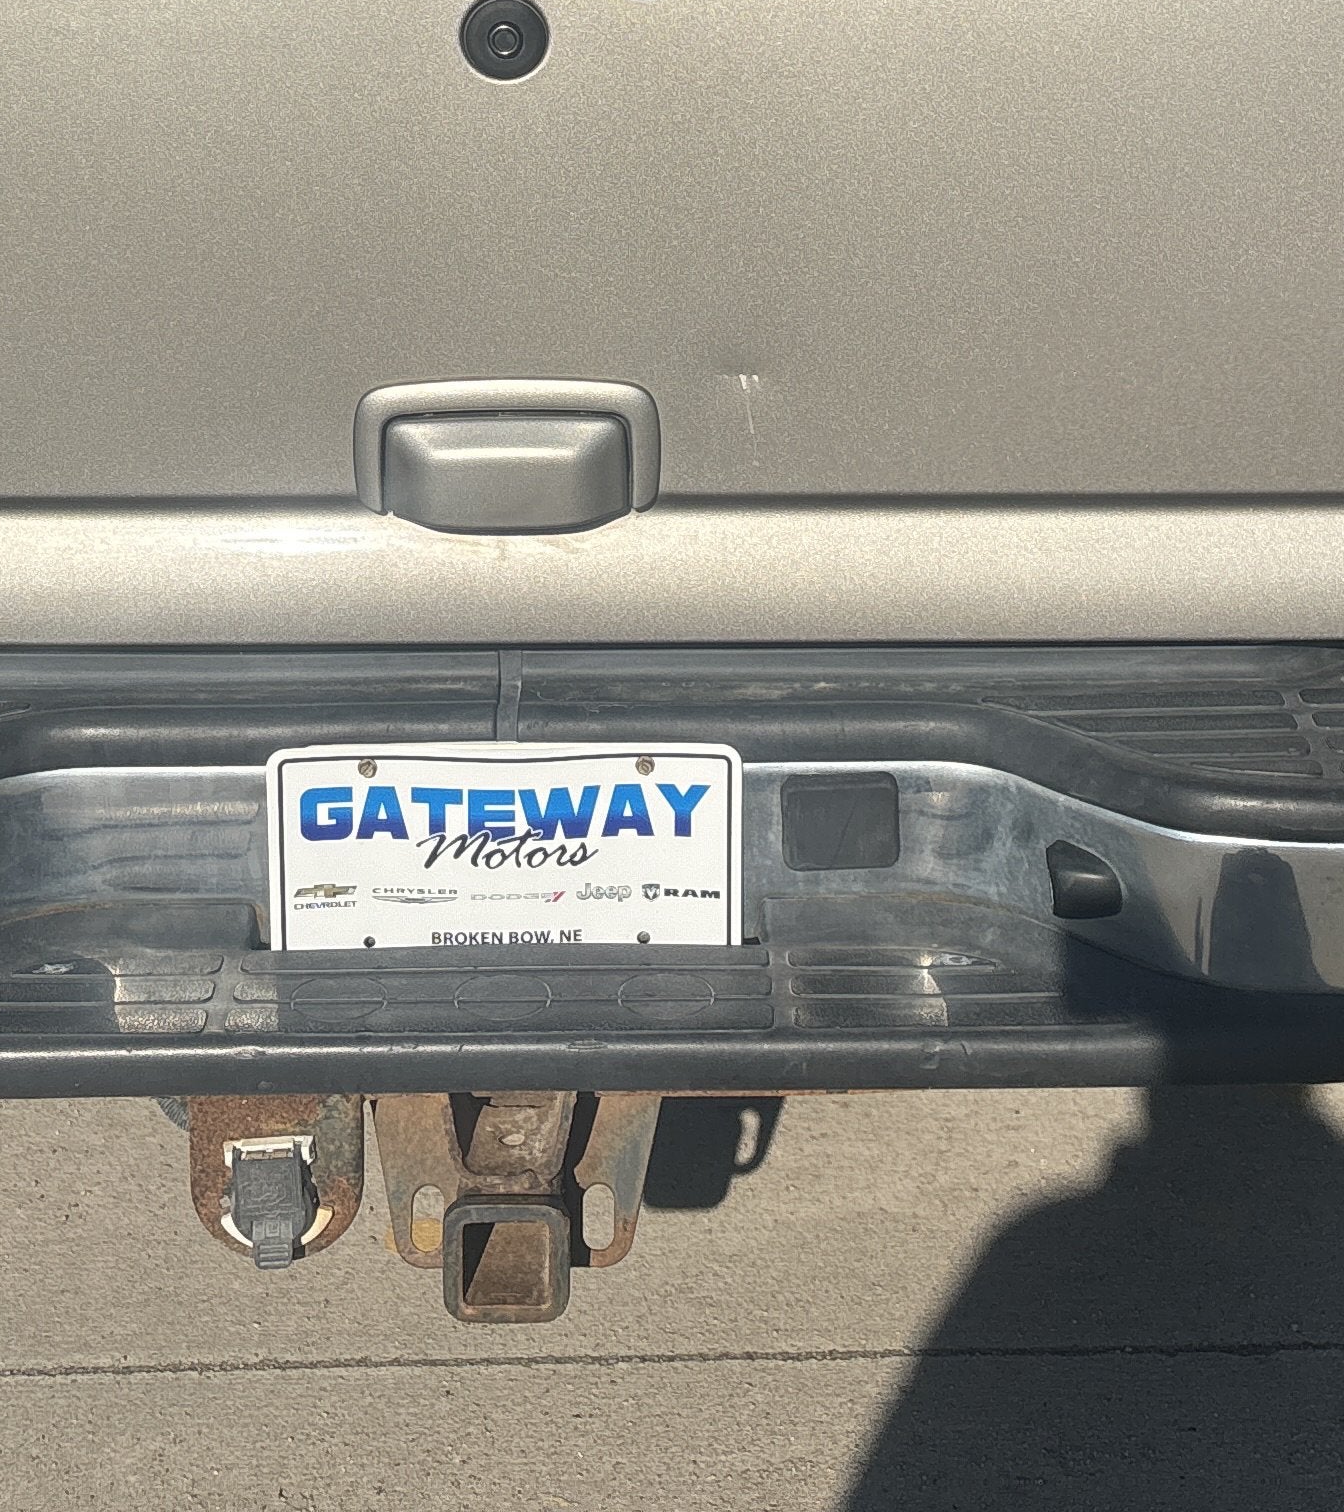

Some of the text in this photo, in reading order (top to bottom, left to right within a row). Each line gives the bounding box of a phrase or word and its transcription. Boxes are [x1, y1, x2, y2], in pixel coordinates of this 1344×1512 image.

[300, 784, 712, 841] GATEWAY
[416, 826, 599, 870] Motors
[372, 887, 458, 896] CHRYSLER
[576, 882, 633, 903] Jeep
[663, 888, 721, 900] RAM
[431, 930, 504, 946] BROKEN
[559, 928, 583, 943] NE
